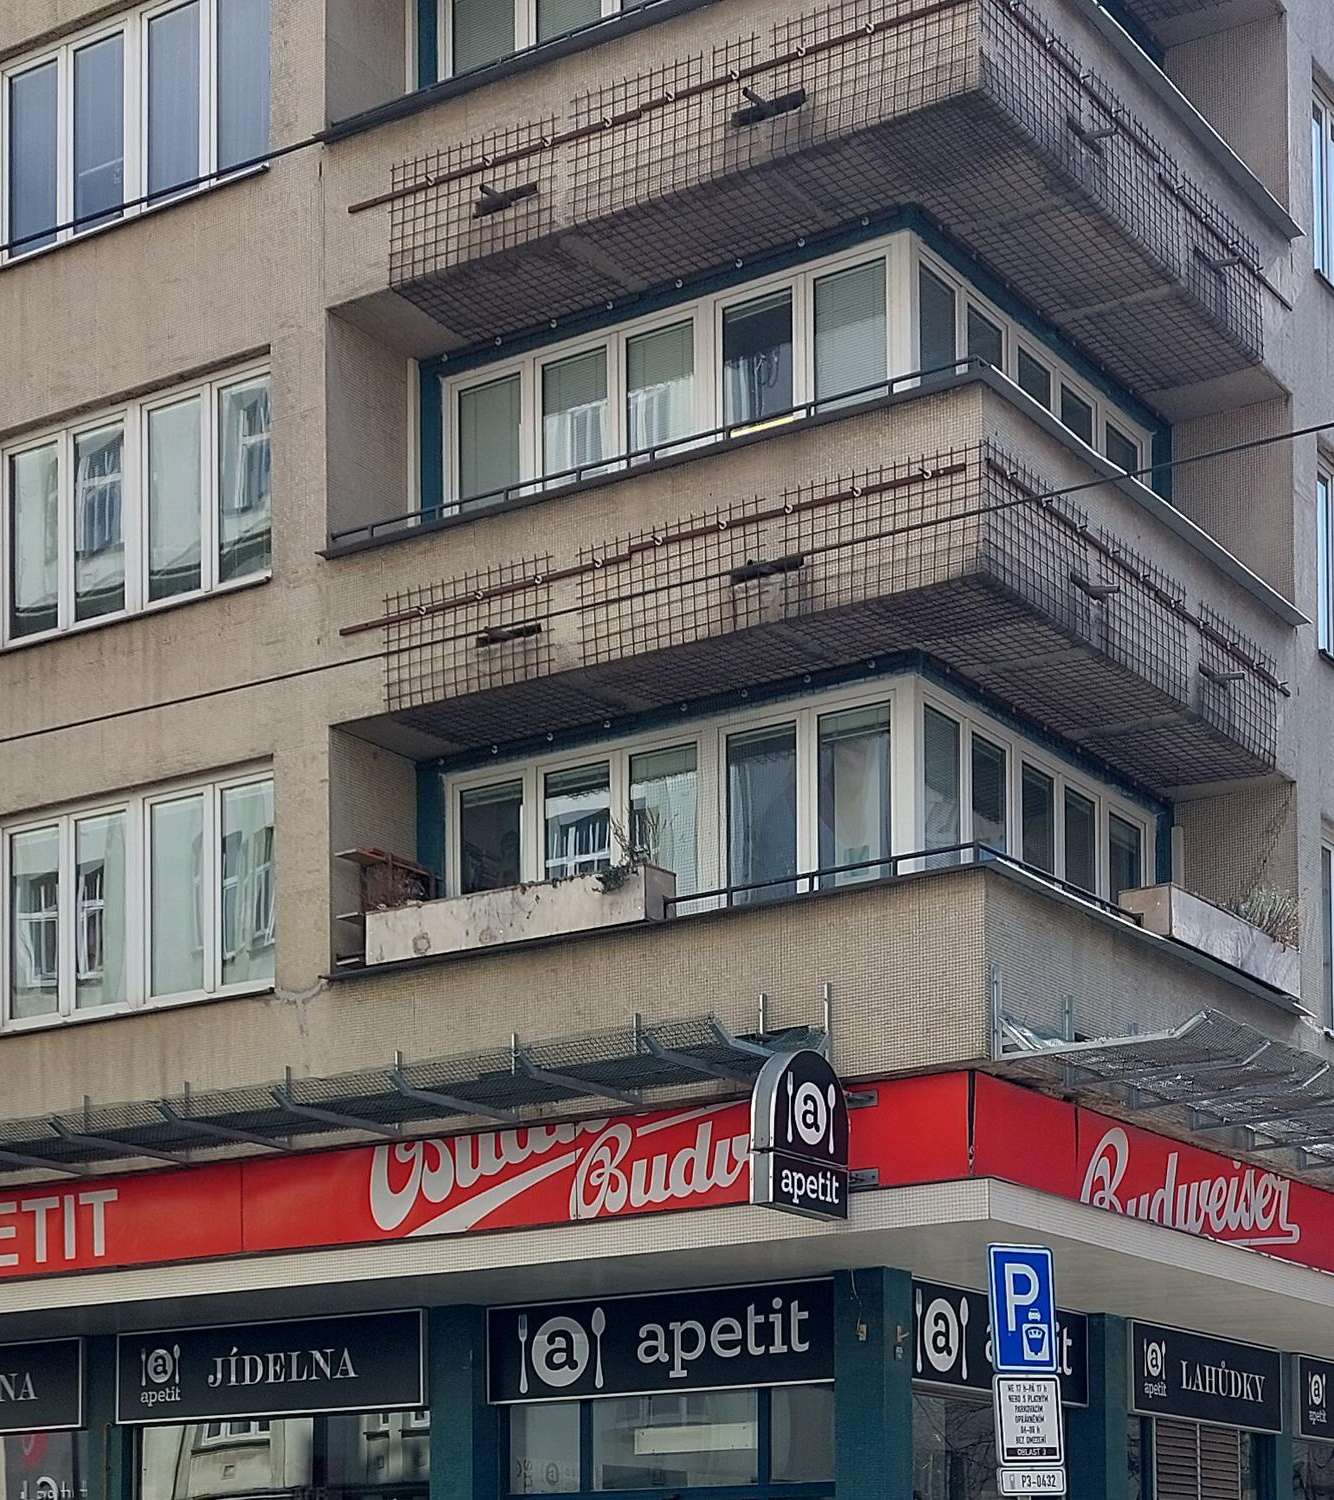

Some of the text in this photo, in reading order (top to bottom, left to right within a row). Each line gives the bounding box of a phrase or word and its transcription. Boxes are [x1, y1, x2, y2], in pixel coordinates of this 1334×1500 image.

[781, 1168, 839, 1204] apetit
[1080, 1126, 1301, 1246] Budweiser
[1004, 1262, 1040, 1332] P
[636, 1296, 811, 1379] apetit
[208, 1345, 360, 1388] JÍDELNA
[1179, 1359, 1266, 1403] LAHŮDKY
[140, 1385, 182, 1408] apetit
[1143, 1380, 1168, 1399] apetit
[1017, 1448, 1041, 1456] OBLAST
